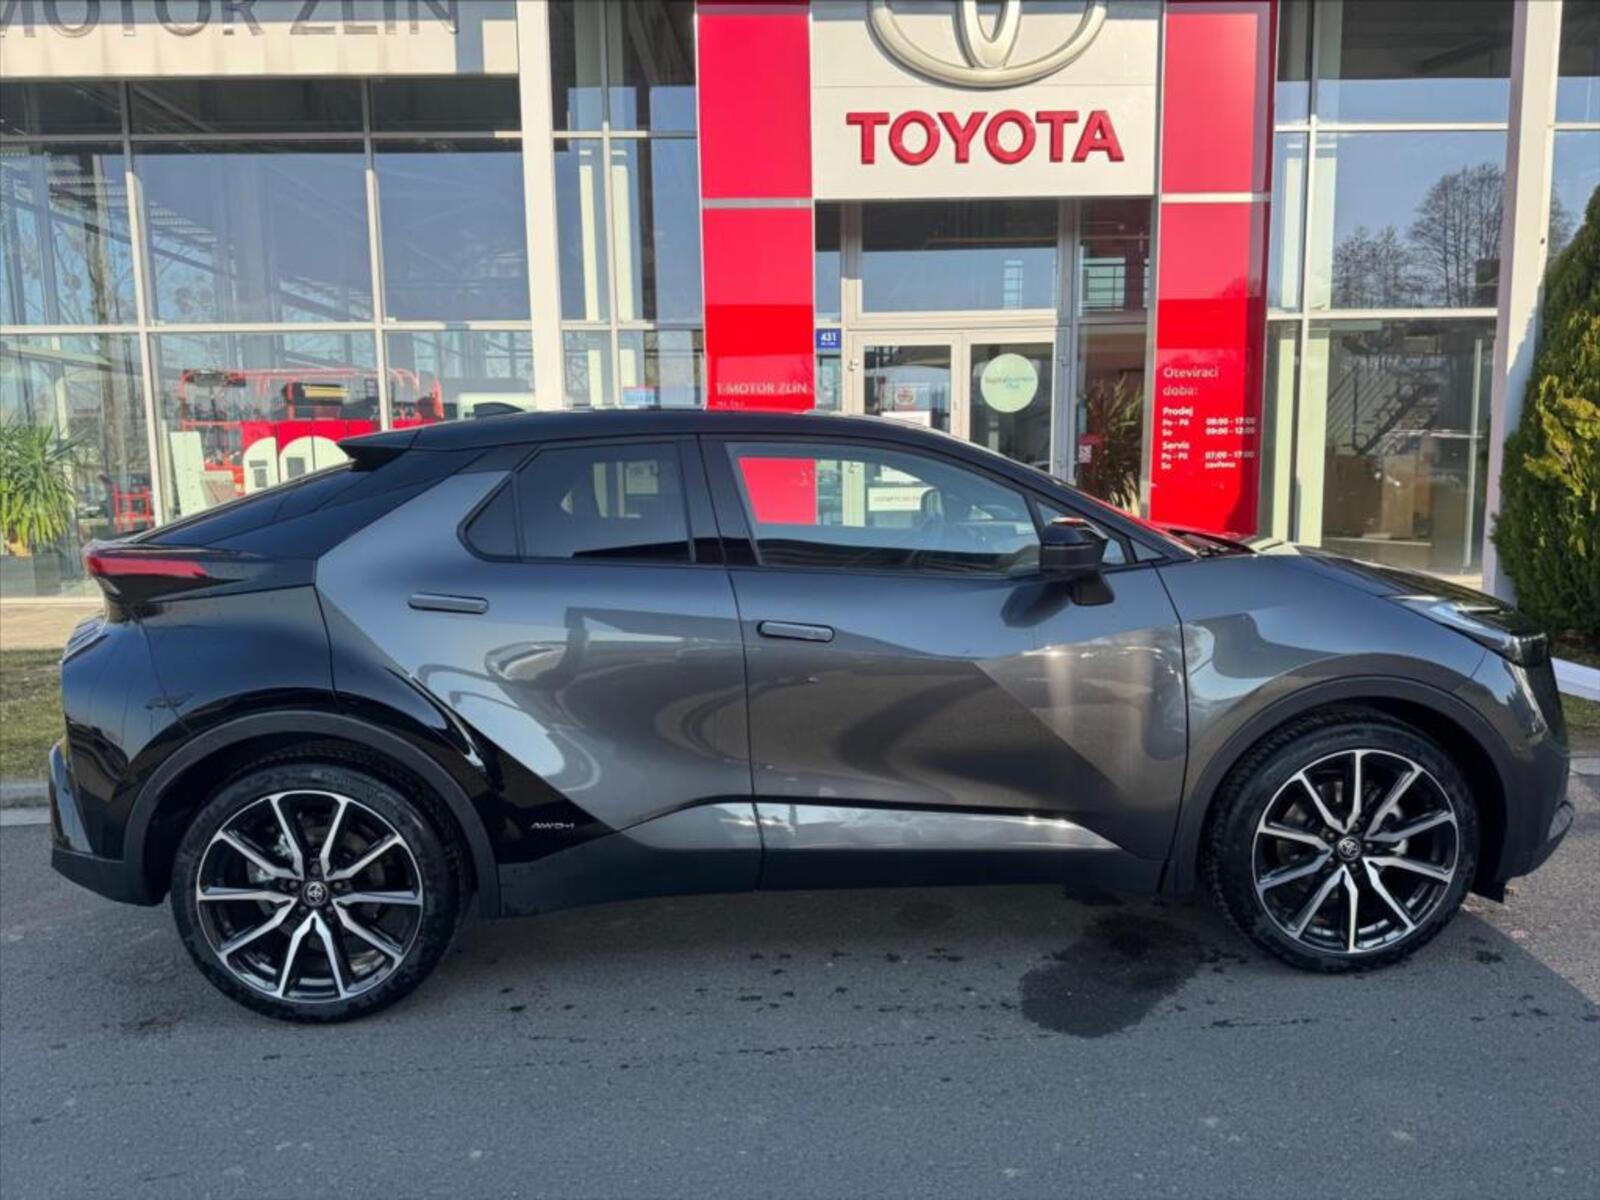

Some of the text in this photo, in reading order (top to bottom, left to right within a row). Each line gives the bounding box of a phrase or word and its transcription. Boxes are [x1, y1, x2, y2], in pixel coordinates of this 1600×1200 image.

[0, 0, 265, 38] OOR
[846, 110, 1125, 166] TOYOTA
[1162, 407, 1193, 417] Prodej
[1162, 440, 1190, 450] Servis
